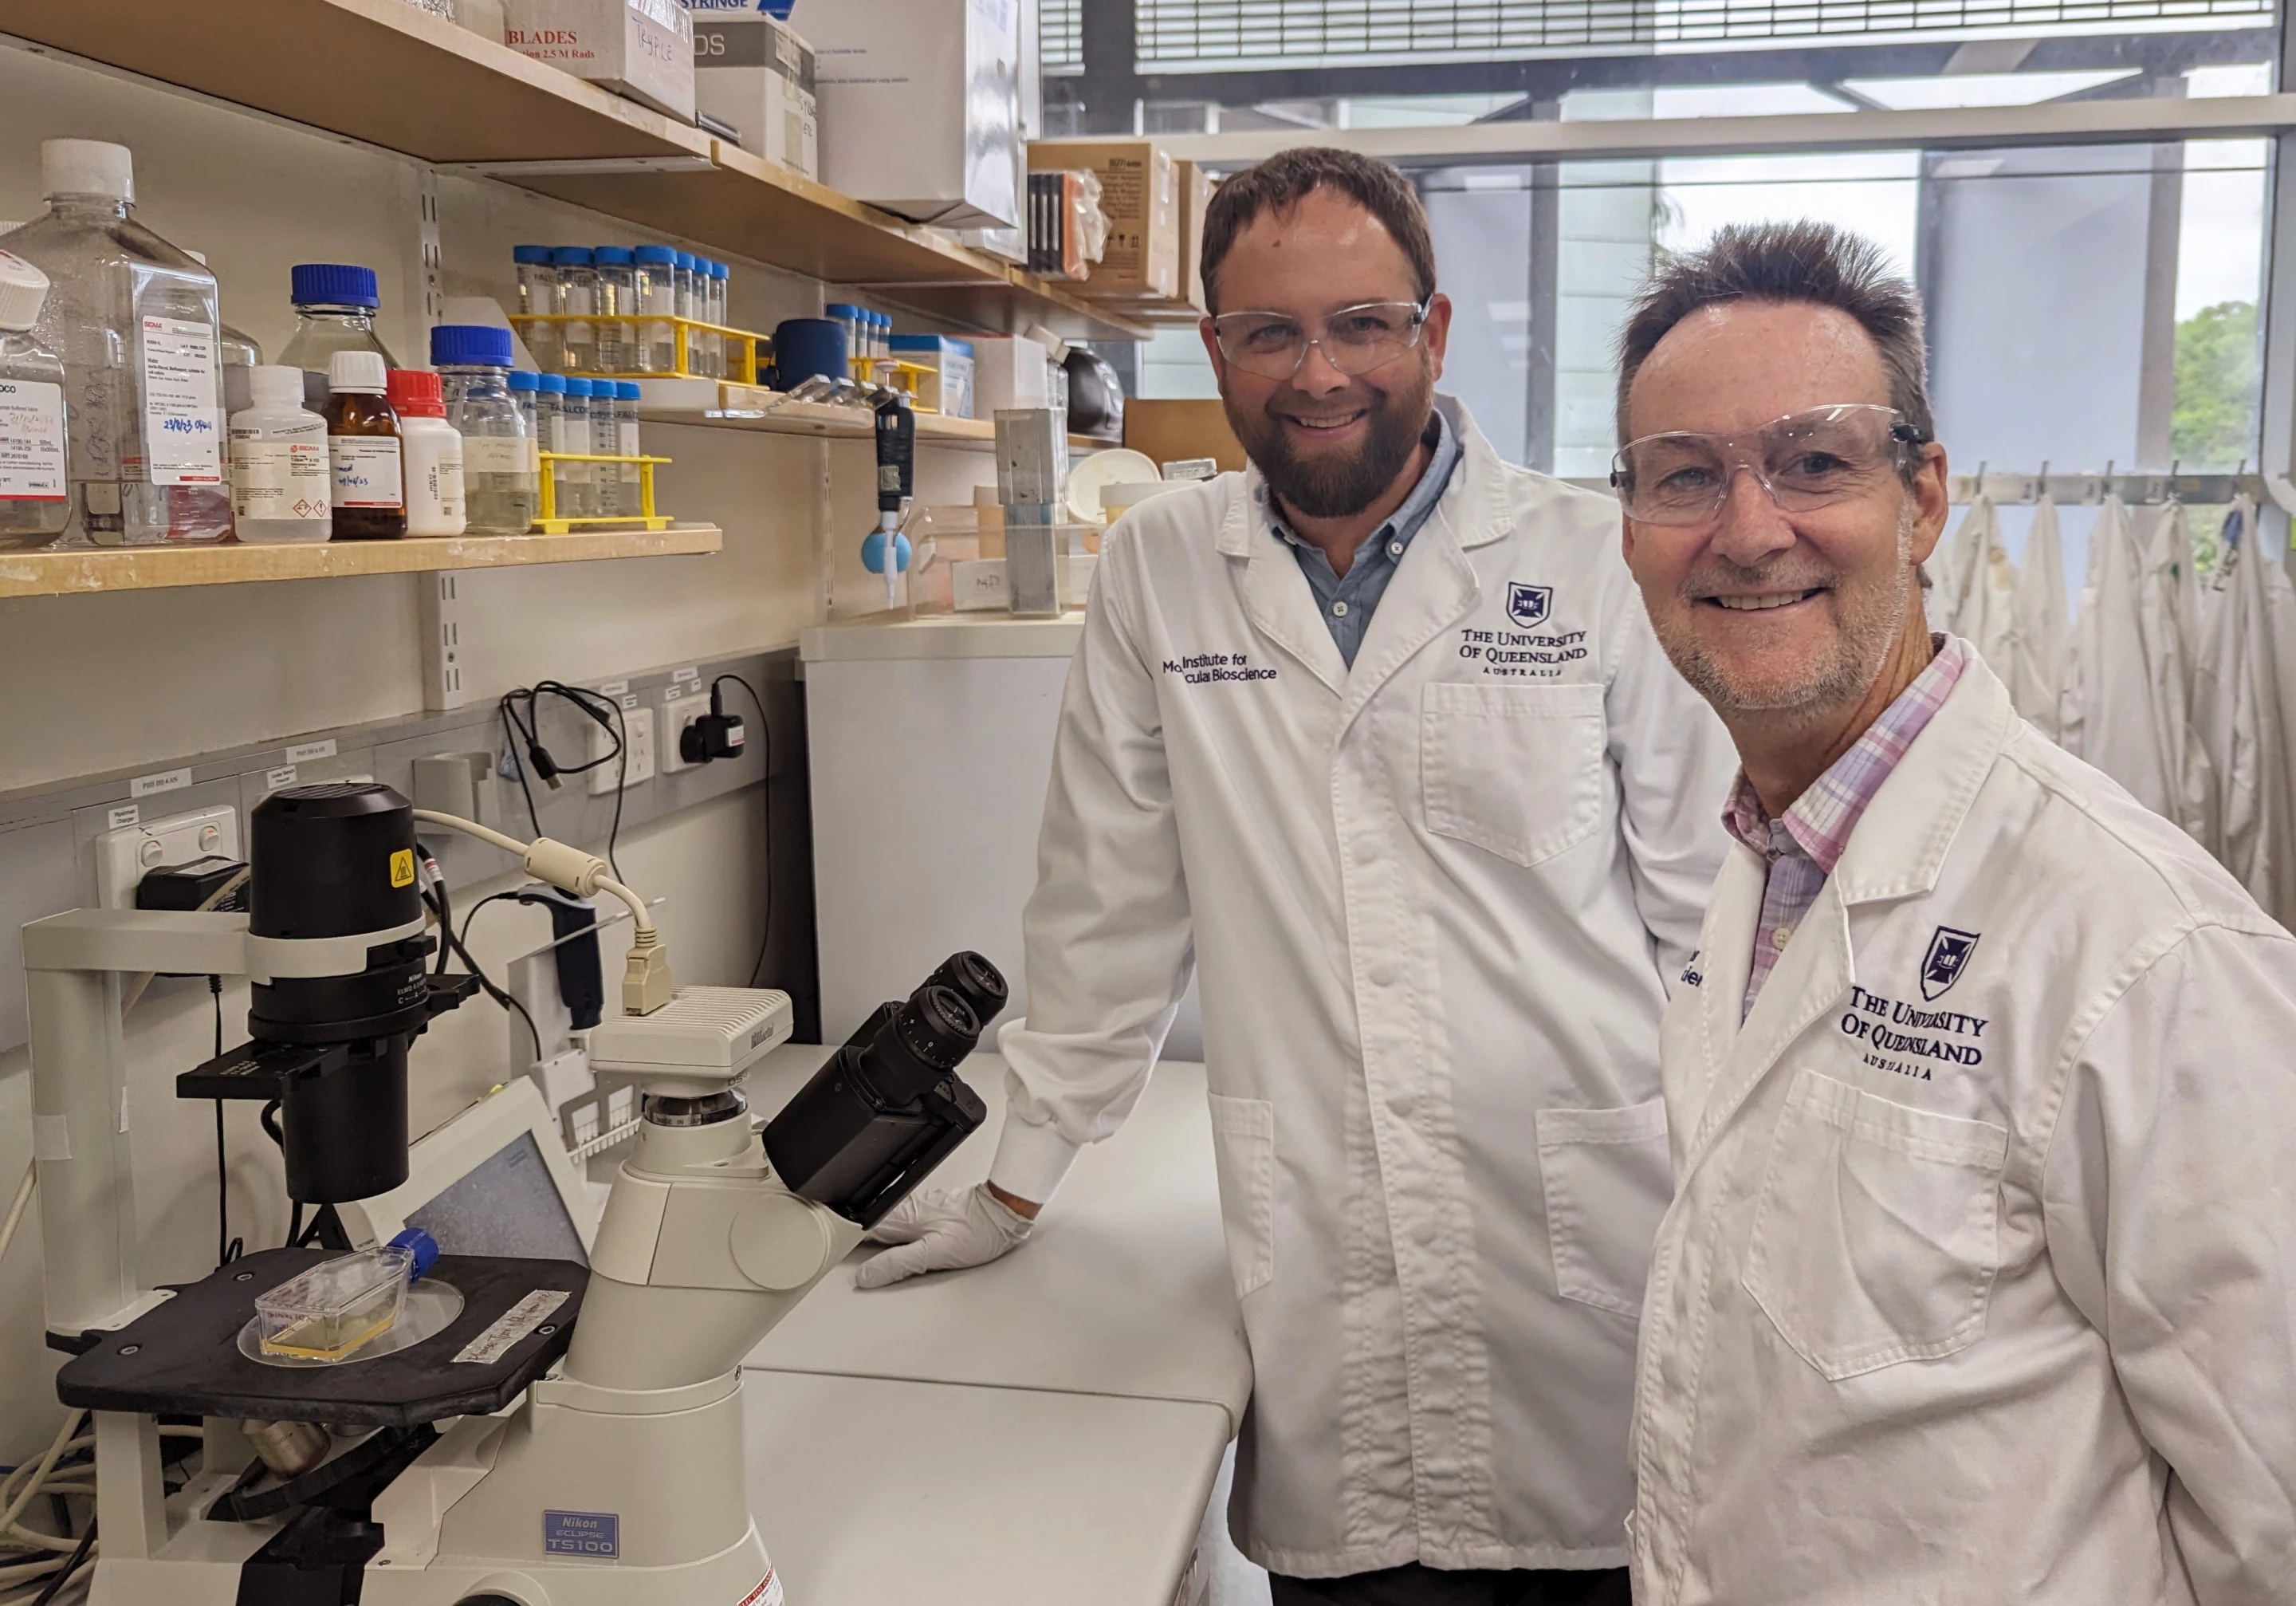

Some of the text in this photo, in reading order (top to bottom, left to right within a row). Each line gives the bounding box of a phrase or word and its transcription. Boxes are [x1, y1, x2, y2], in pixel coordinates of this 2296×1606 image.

[508, 31, 577, 44] BLADES
[522, 49, 596, 58] tion 2.5 M Rads
[1461, 629, 1586, 648] THE UNIVERSITY
[1182, 653, 1247, 668] Institute for
[1460, 645, 1587, 664] OF QUEENSLAND
[1212, 667, 1277, 682] Bioscience
[1483, 667, 1562, 677] AUSTRALIA
[1850, 986, 1889, 1017] THE
[1841, 1014, 1870, 1038] OF
[562, 1517, 597, 1529] Nikon
[556, 1529, 604, 1539] ECLIPSE
[548, 1538, 613, 1553] TS100
